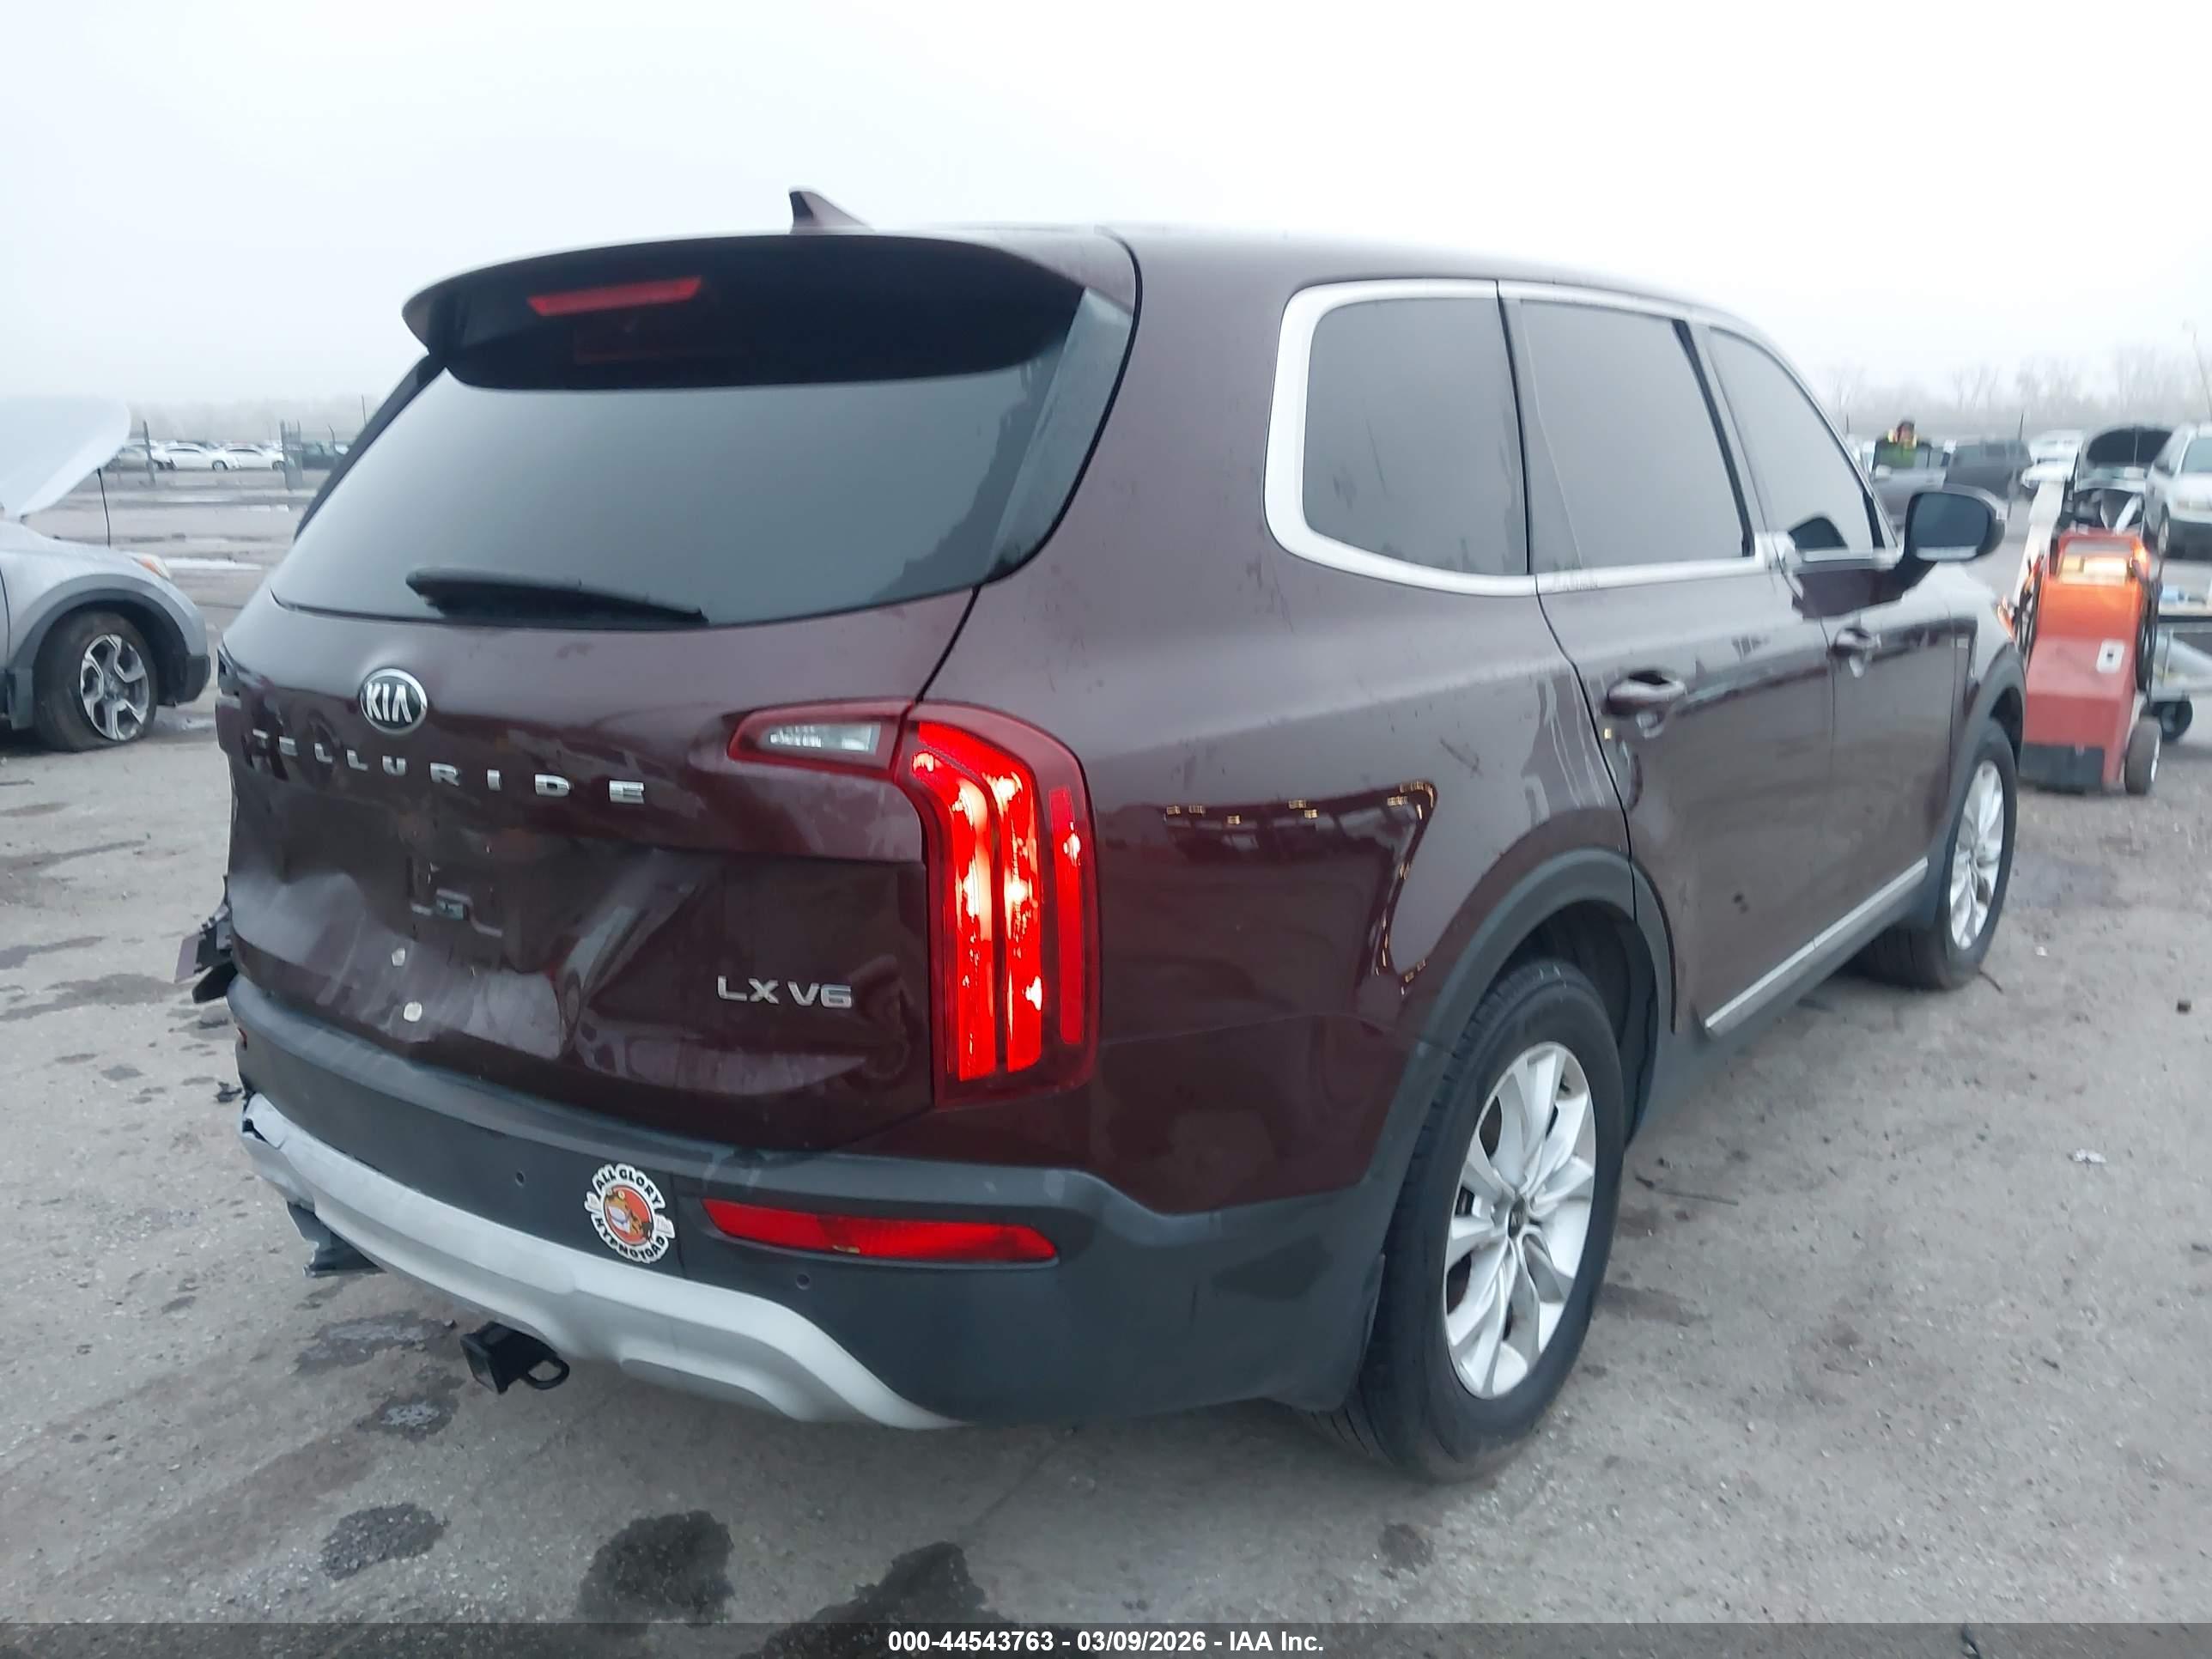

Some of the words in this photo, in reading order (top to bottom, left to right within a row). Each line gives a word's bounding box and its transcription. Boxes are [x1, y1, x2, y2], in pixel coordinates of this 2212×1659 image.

[366, 684, 413, 723] KIA
[252, 728, 645, 805] TELLURIDE
[717, 975, 780, 1005] LX
[787, 981, 852, 1009] V6
[595, 1169, 617, 1192] ALL
[619, 1169, 661, 1204] GLORY
[594, 1217, 665, 1260] HYPNOTOAD
